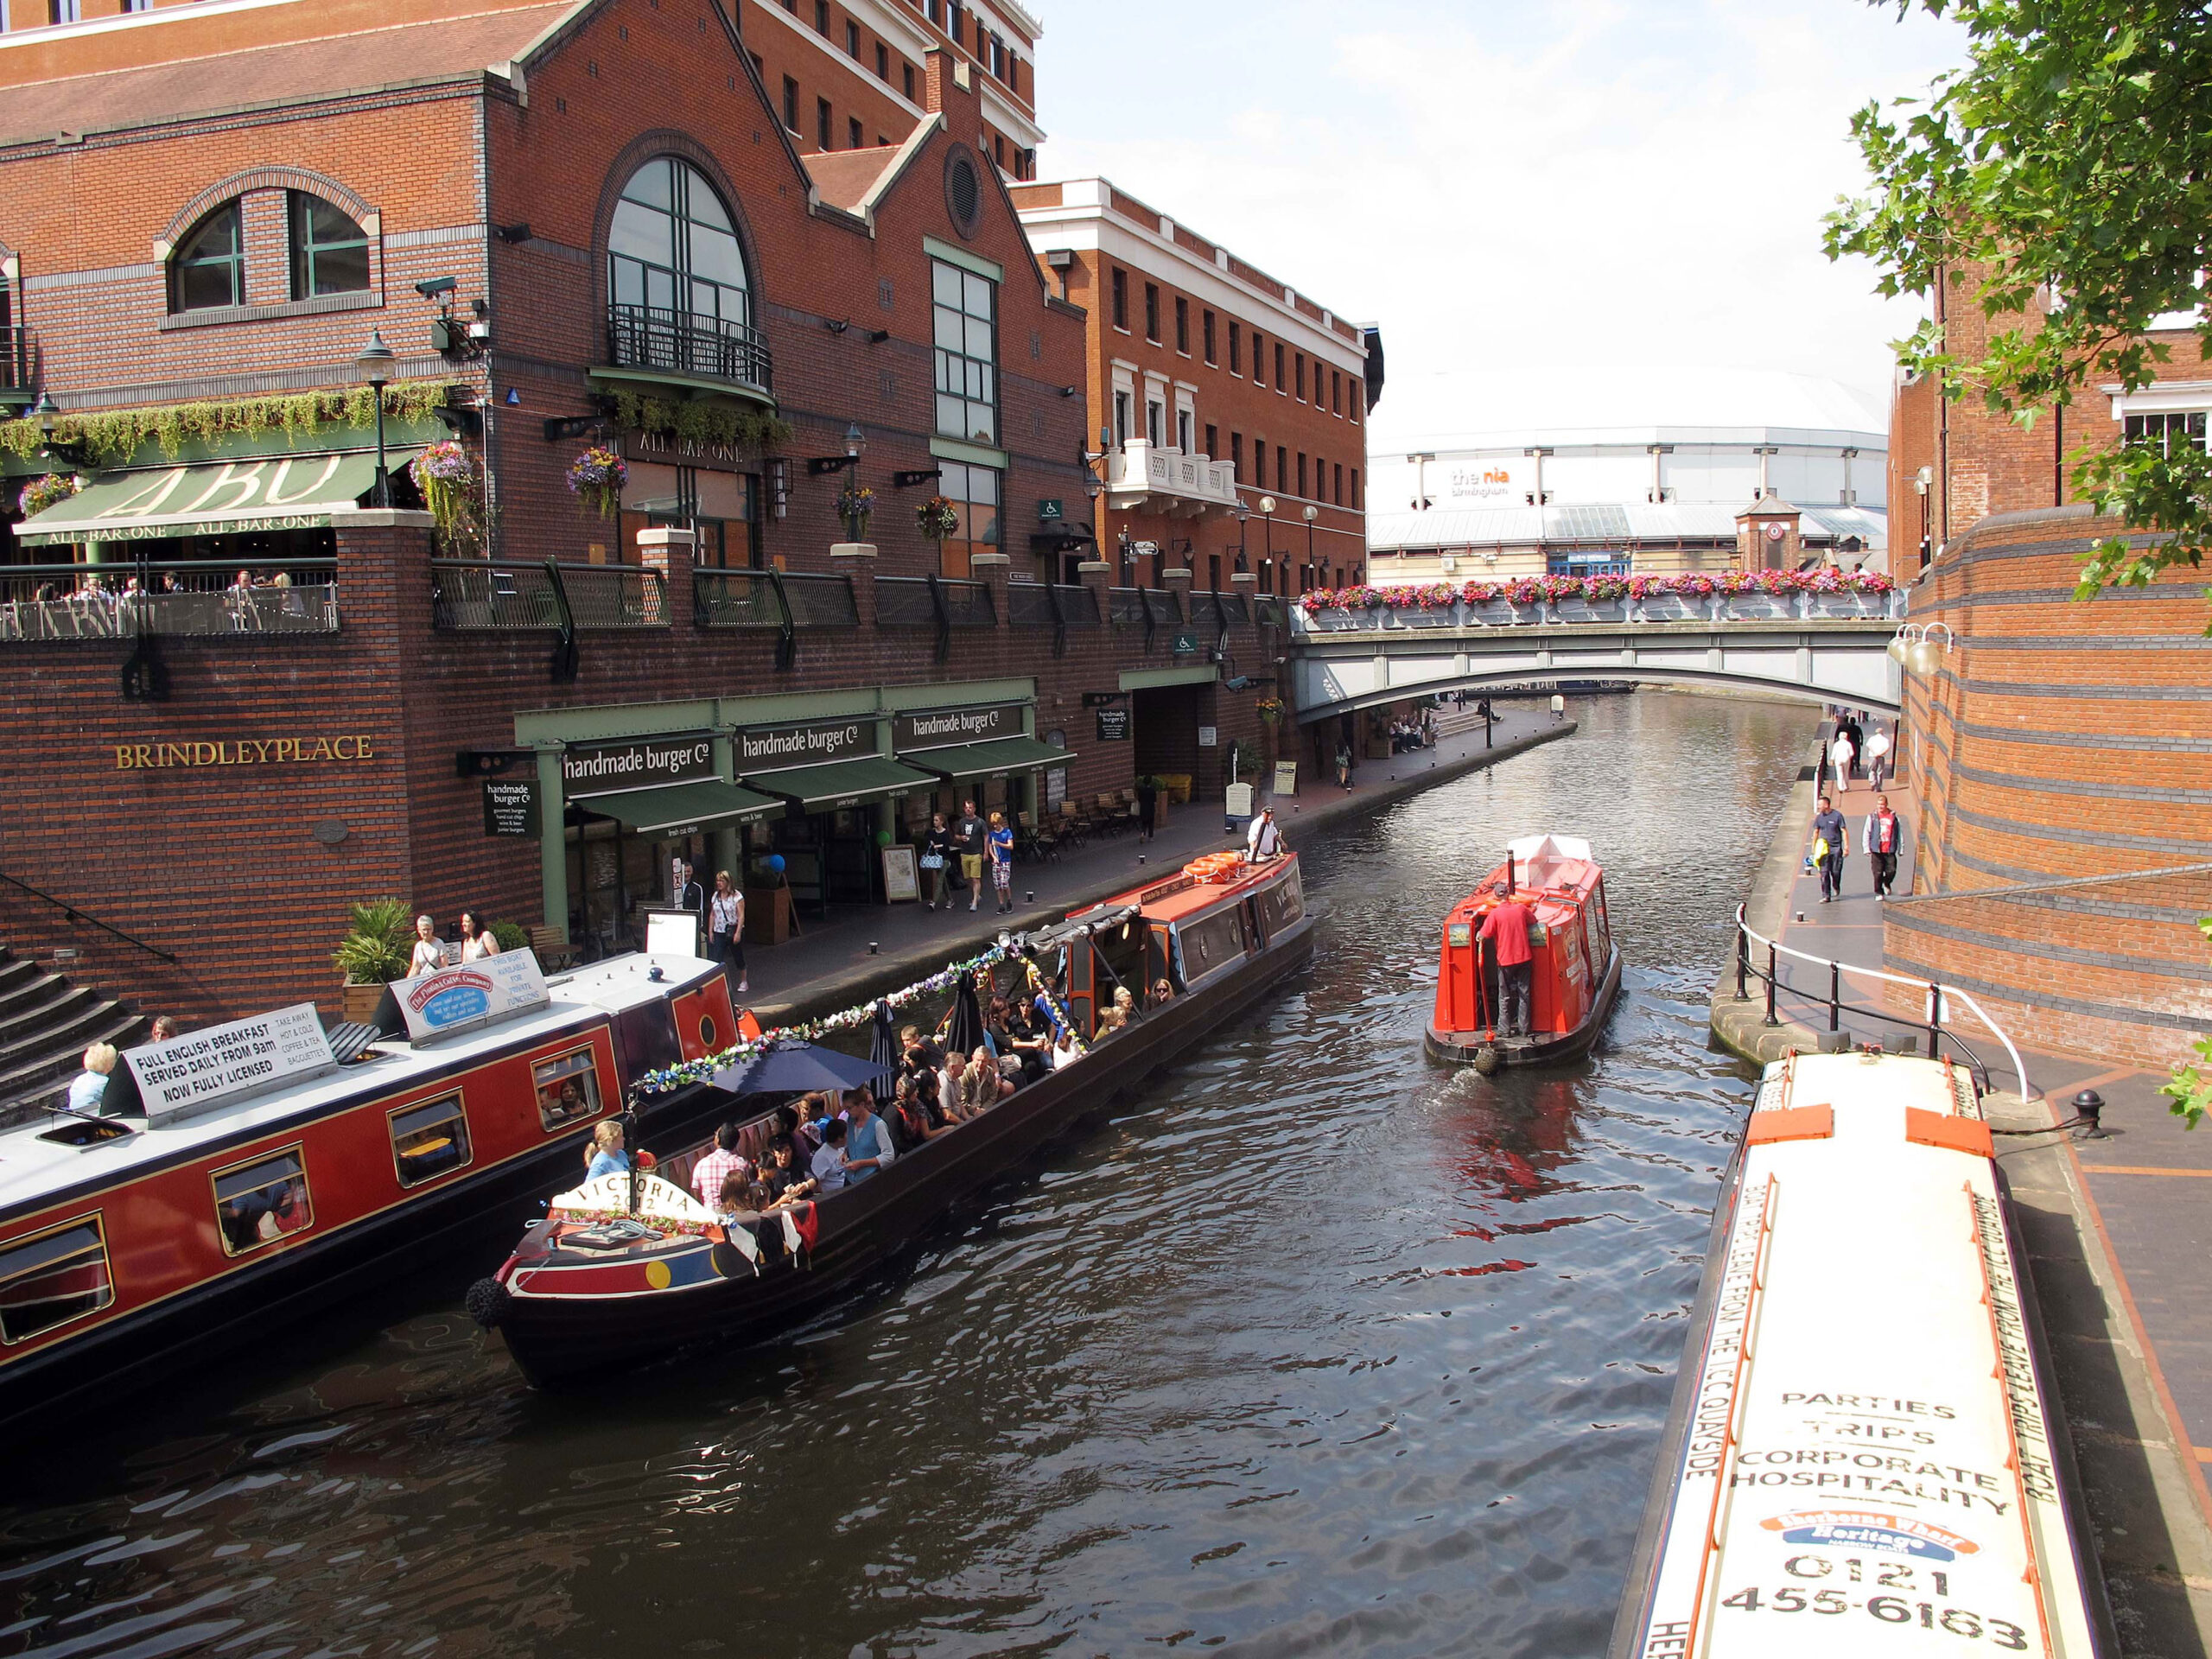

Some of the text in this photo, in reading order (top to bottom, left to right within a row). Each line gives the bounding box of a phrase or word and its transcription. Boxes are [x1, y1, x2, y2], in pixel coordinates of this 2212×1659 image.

[1452, 467, 1510, 486] the nia
[48, 525, 168, 545] ALL BAR ONE
[195, 515, 321, 536] ALL BAR ONE
[913, 714, 960, 736] handmade
[961, 713, 989, 734] burger
[115, 735, 373, 769] BRINDLEYPLACE
[743, 728, 805, 757] handmade
[808, 729, 844, 753] burger
[565, 747, 644, 779] handmade
[646, 746, 692, 773] burger
[487, 784, 529, 794] handmade
[494, 793, 520, 805] burger
[276, 1012, 309, 1027] TAKE AWAY
[280, 1024, 314, 1039] HOT & COLD
[136, 1023, 270, 1070] FULL ENGLISH BREAKFAST
[282, 1039, 303, 1053] COFFEE
[309, 1036, 321, 1046] TEA
[144, 1039, 276, 1086] SERVED DAILY FROM 9am
[163, 1059, 273, 1103] NOW FULLY LICENSED
[577, 1177, 688, 1211] VICTORIA
[1742, 1185, 1766, 1210] BOAT
[1973, 1192, 2003, 1243] QUAYSIDE
[1727, 1244, 1756, 1282] LEAVE
[1988, 1271, 2016, 1296] THE
[1718, 1286, 1749, 1324] FROM
[1992, 1297, 2024, 1340] FROM
[1712, 1327, 1742, 1356] THE
[1999, 1340, 2035, 1395] LEAVE
[1781, 1393, 1956, 1420] PARTIES
[2008, 1393, 2045, 1443] TRIPS
[1686, 1397, 1730, 1480] QUAYSIDE
[1802, 1421, 1935, 1445] TRIPS
[1737, 1450, 1999, 1493] CORPORATE
[2018, 1446, 2057, 1505] BOAT
[1729, 1471, 2011, 1516] HOSPITALITY
[1777, 1511, 1967, 1547] Sherborne Wharf
[1811, 1525, 1926, 1549] Heritage
[1784, 1554, 1948, 1597] 0121
[1721, 1586, 2028, 1650] 455-6163
